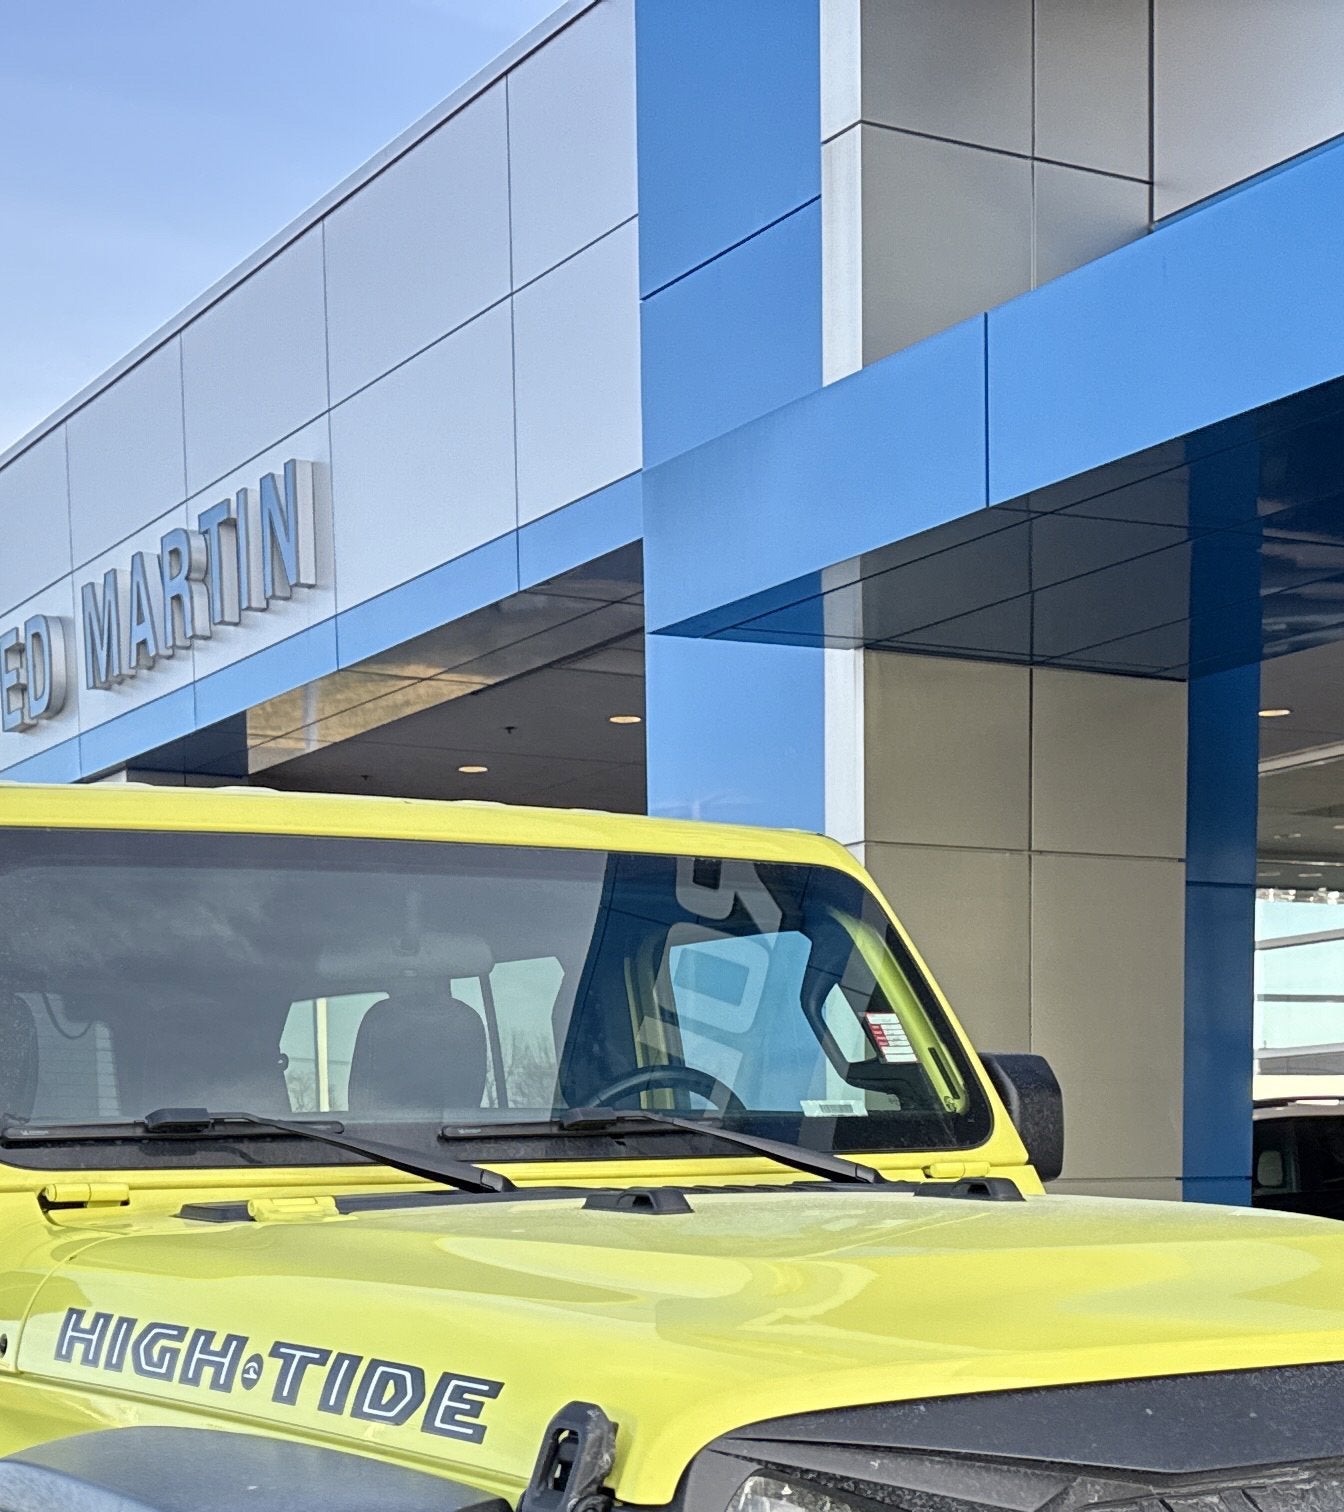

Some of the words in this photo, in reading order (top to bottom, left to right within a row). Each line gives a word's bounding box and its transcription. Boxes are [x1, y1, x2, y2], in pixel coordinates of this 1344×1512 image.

[81, 458, 315, 690] MARTIN
[54, 1307, 249, 1393] HIGH
[268, 1340, 505, 1444] TIDE
